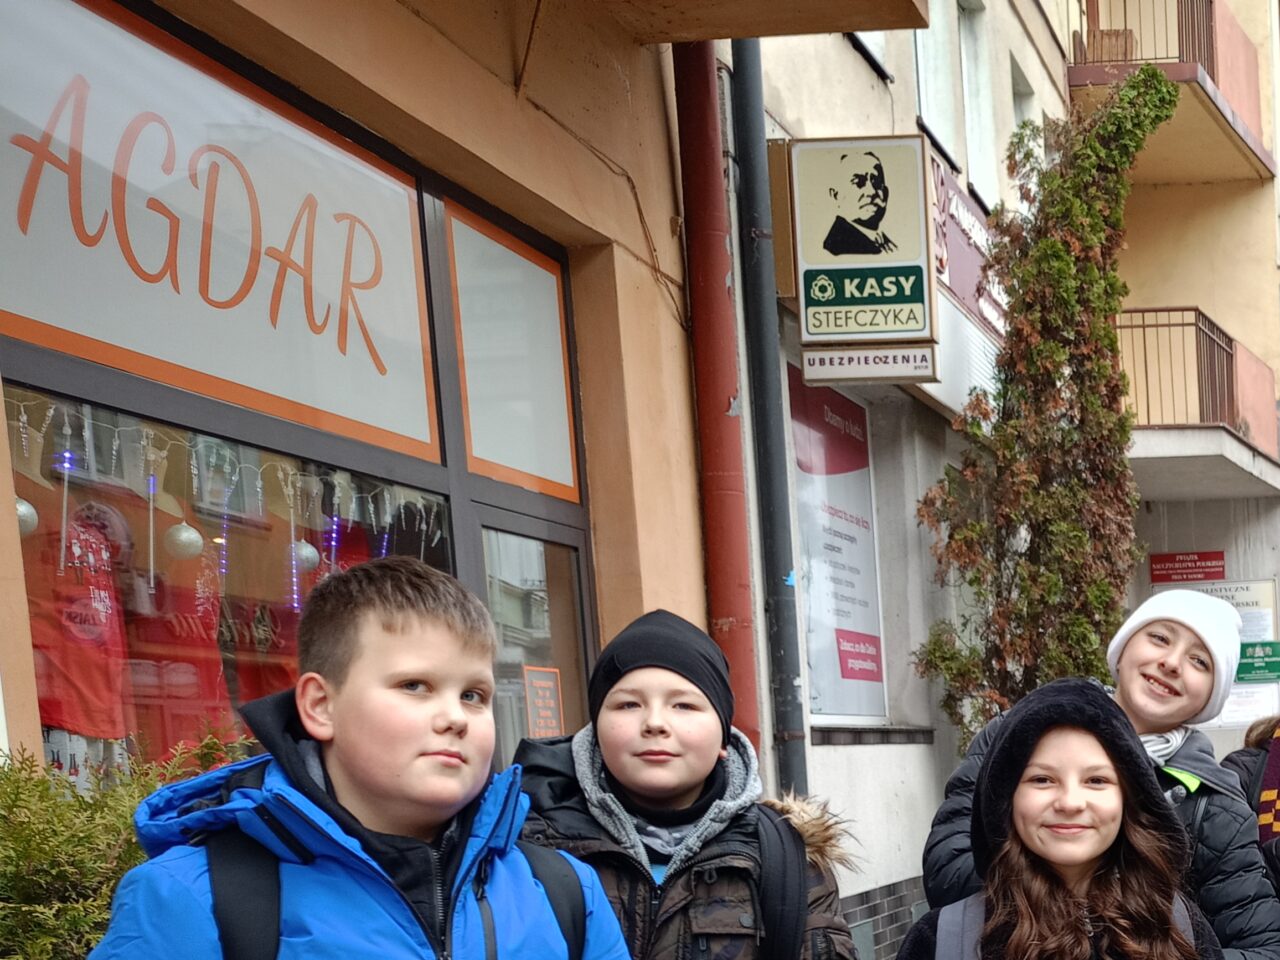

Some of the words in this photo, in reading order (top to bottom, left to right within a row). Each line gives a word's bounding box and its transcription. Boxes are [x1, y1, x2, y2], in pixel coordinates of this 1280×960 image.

[9, 73, 387, 376] AGDAR
[844, 276, 916, 298] KASY
[812, 308, 919, 329] STEFCZYKA
[807, 354, 928, 367] UBEZPIECZENIA
